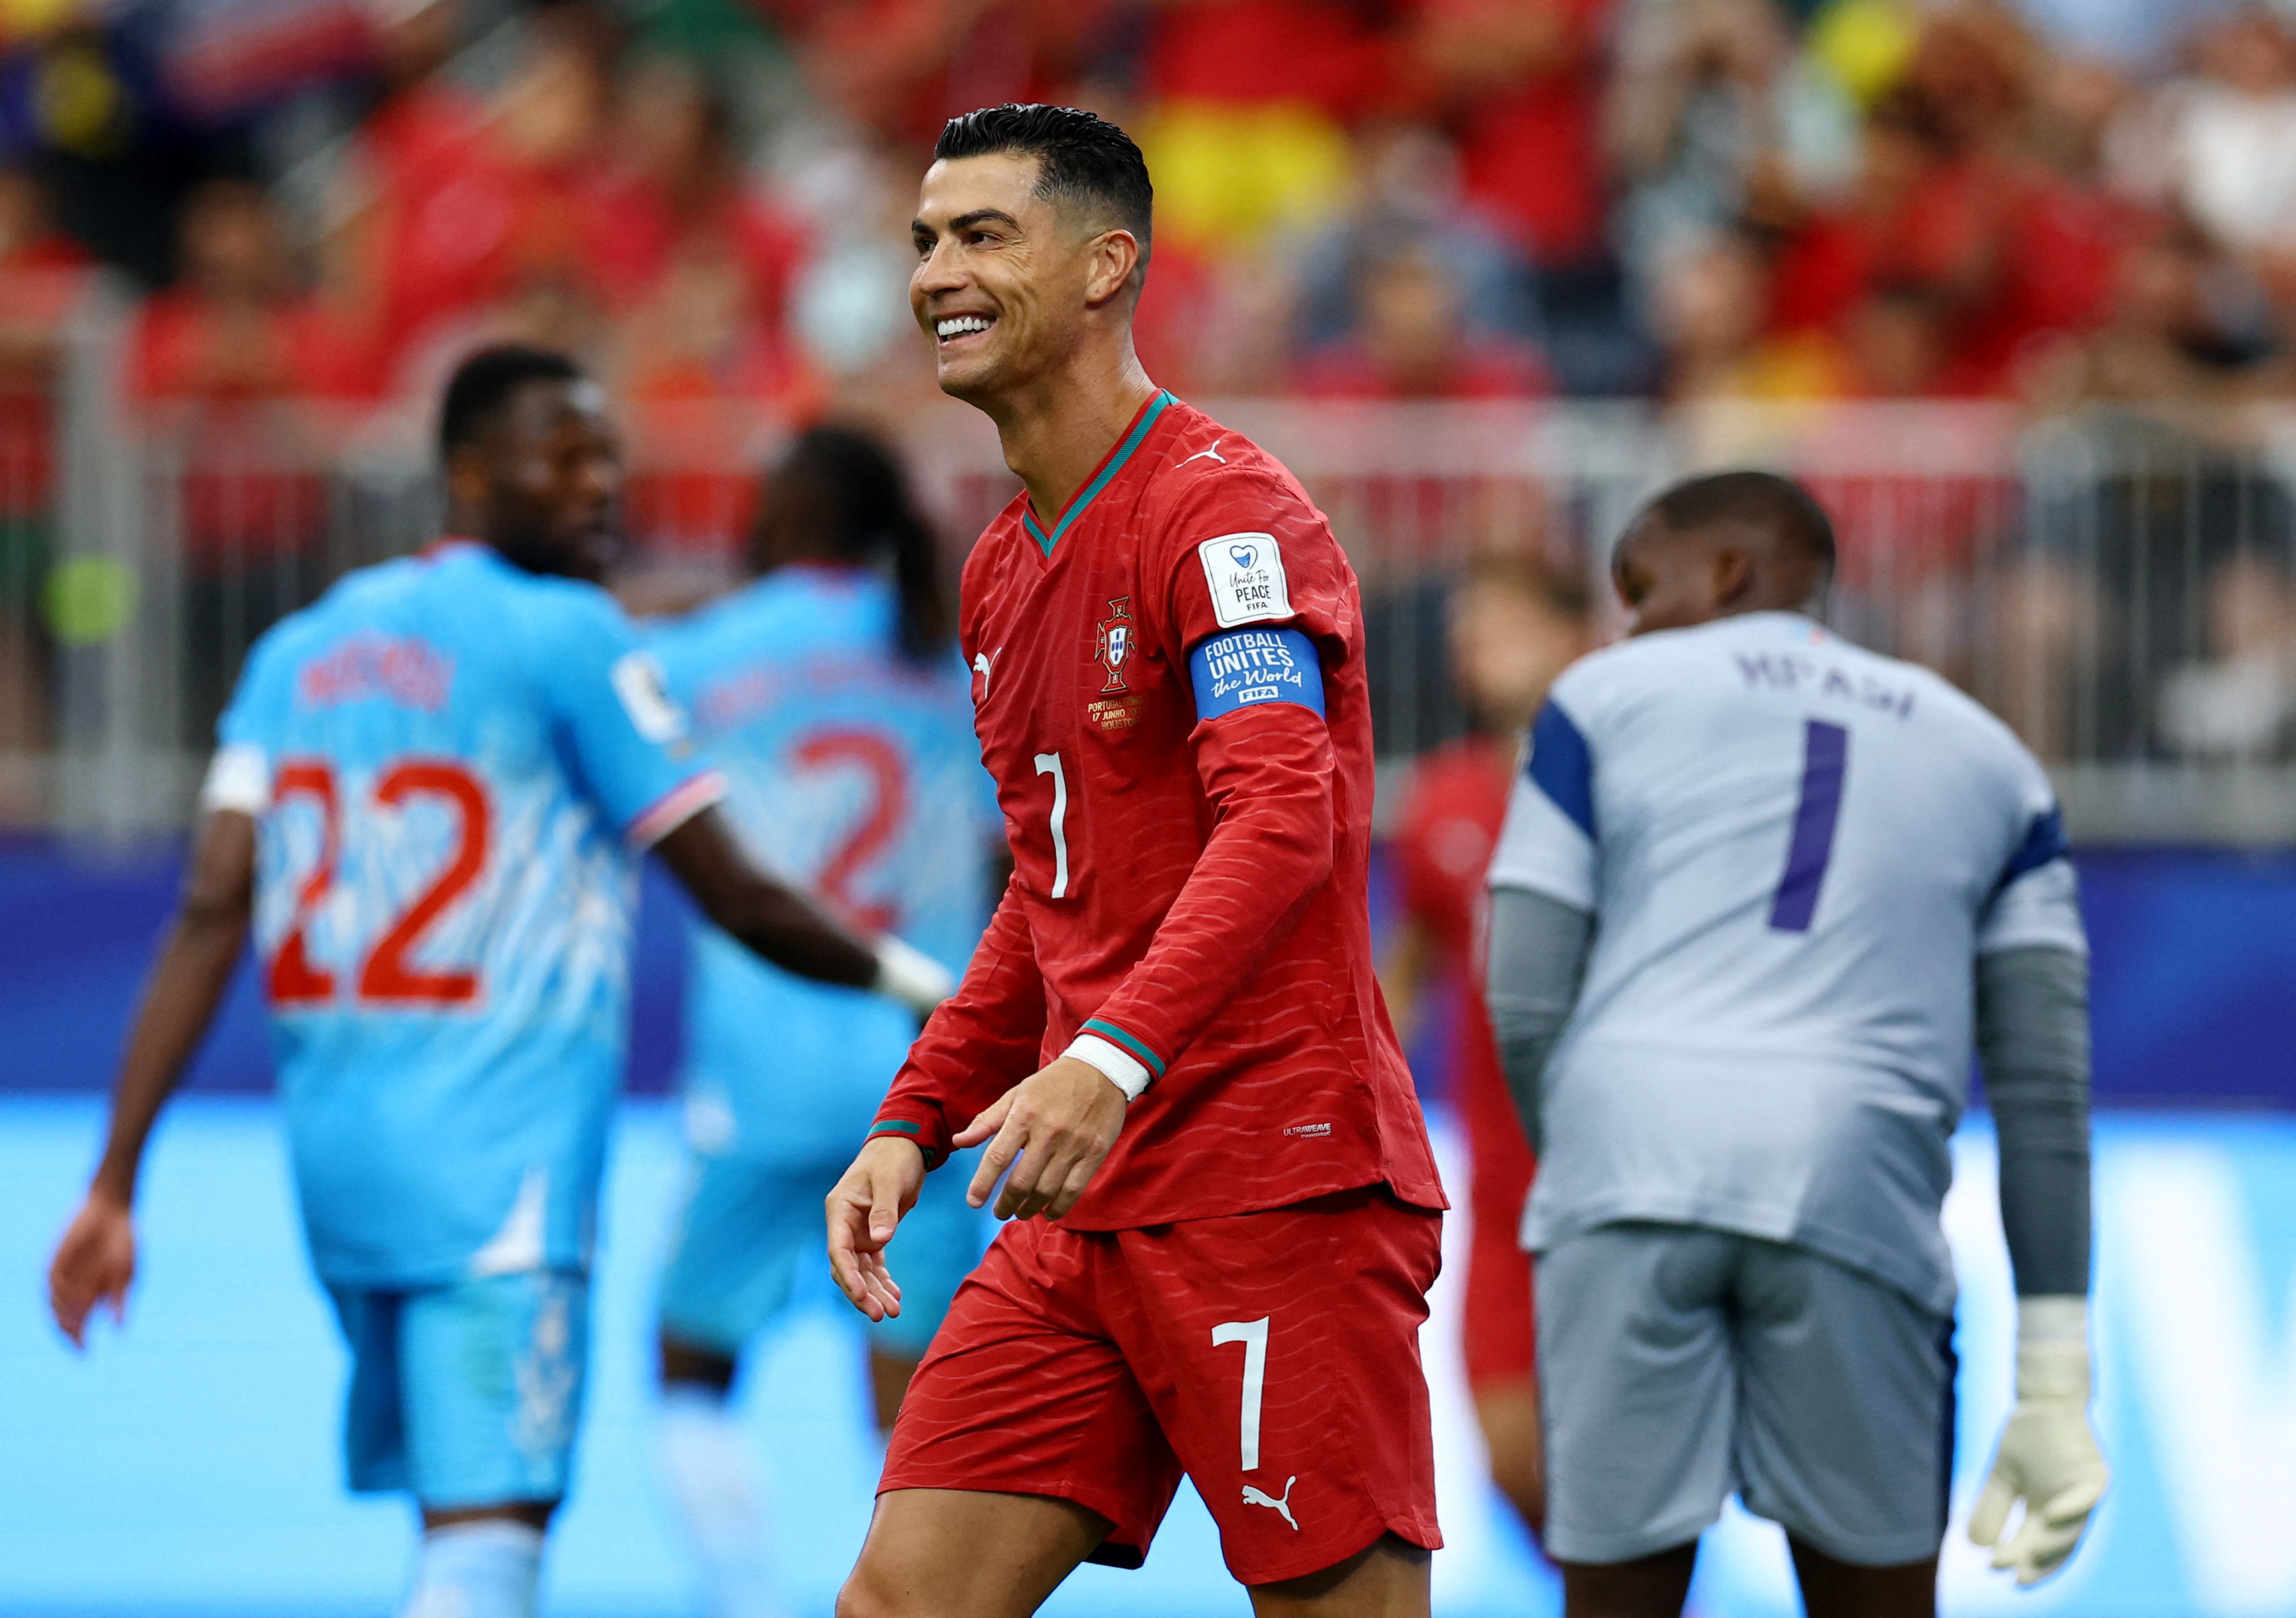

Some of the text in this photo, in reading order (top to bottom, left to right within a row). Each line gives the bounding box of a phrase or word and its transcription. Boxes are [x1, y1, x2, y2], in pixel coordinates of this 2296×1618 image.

[1229, 569, 1269, 588] Unite For
[1235, 585, 1271, 603] PEACE
[1246, 601, 1268, 611] FIFA
[1205, 633, 1288, 662] FOOTBALL
[1209, 648, 1295, 679] UNITES
[1211, 666, 1302, 698] the World
[1243, 688, 1275, 700] FIFA
[1088, 699, 1123, 713] PORTUGAL
[1092, 712, 1101, 722] 17
[1102, 709, 1126, 721] JUNHO
[790, 729, 908, 936] 2
[1034, 751, 1068, 899] 7
[1768, 718, 1848, 933] 1
[269, 755, 491, 1003] 22
[1283, 1123, 1331, 1136] ULTRAWEAVE
[1211, 1315, 1269, 1471] 7
